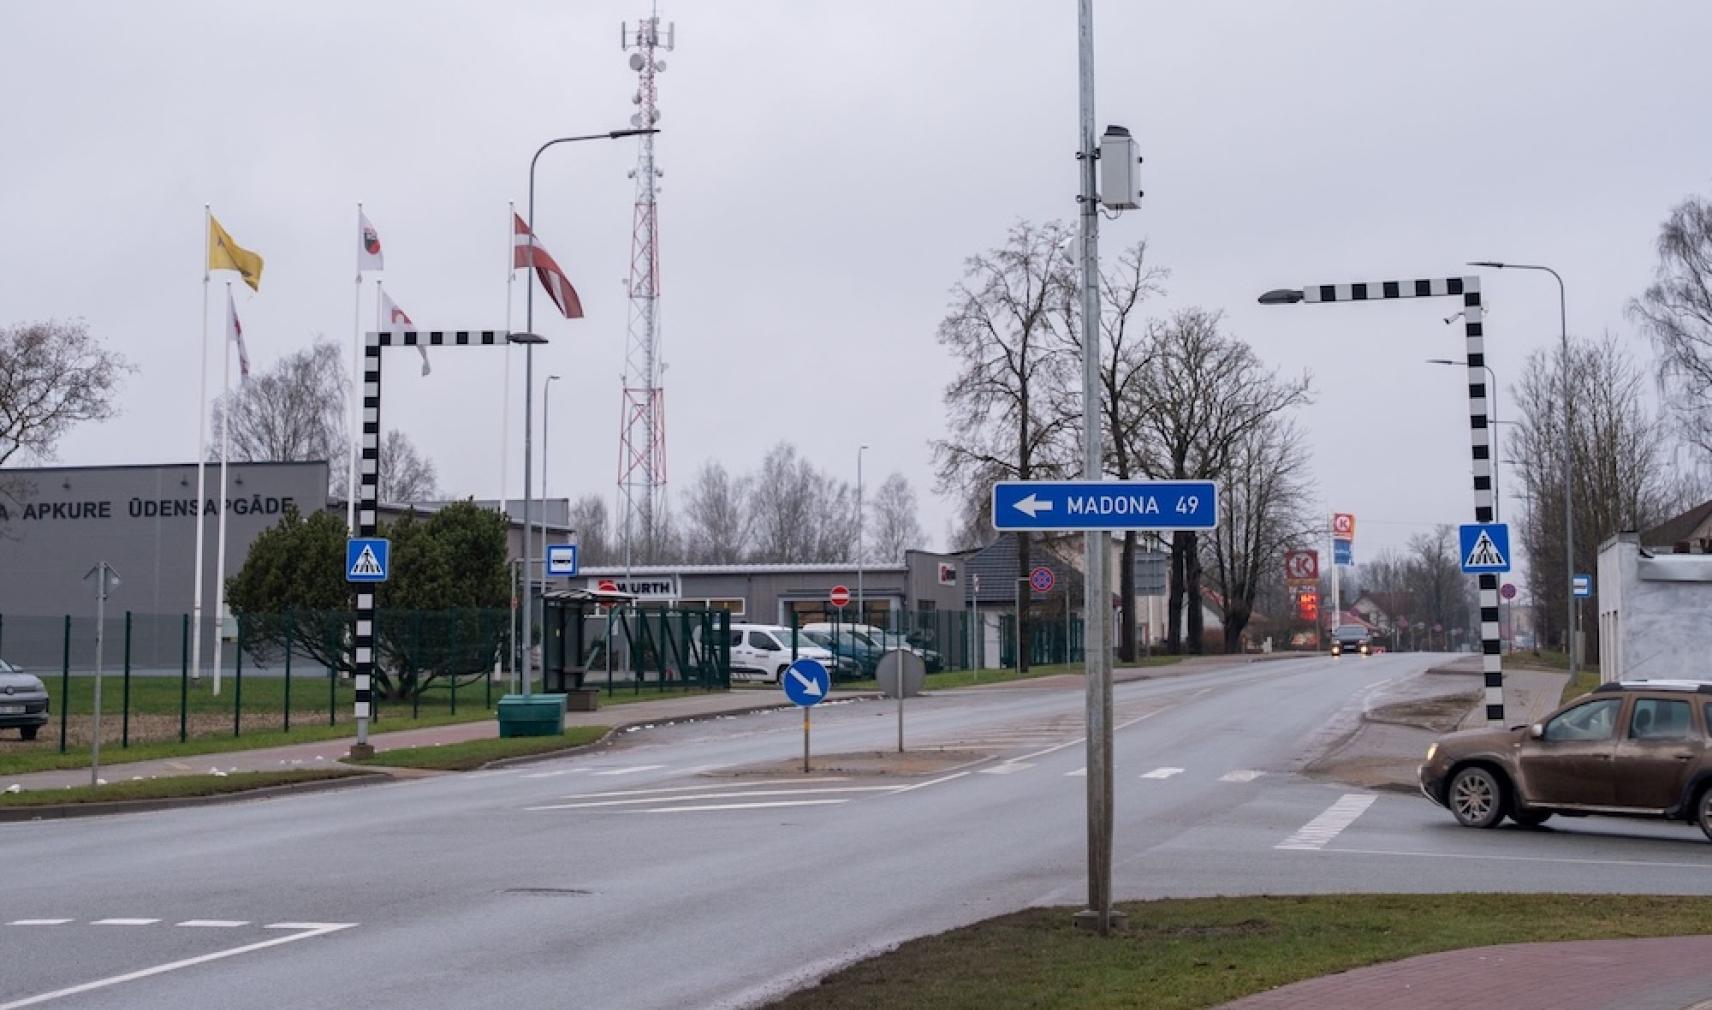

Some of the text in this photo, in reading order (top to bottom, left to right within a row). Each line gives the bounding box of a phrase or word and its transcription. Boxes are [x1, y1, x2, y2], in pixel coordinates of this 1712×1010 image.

[22, 501, 112, 520] APKURE
[1067, 496, 1200, 515] MADONA 49
[1296, 557, 1311, 575] K
